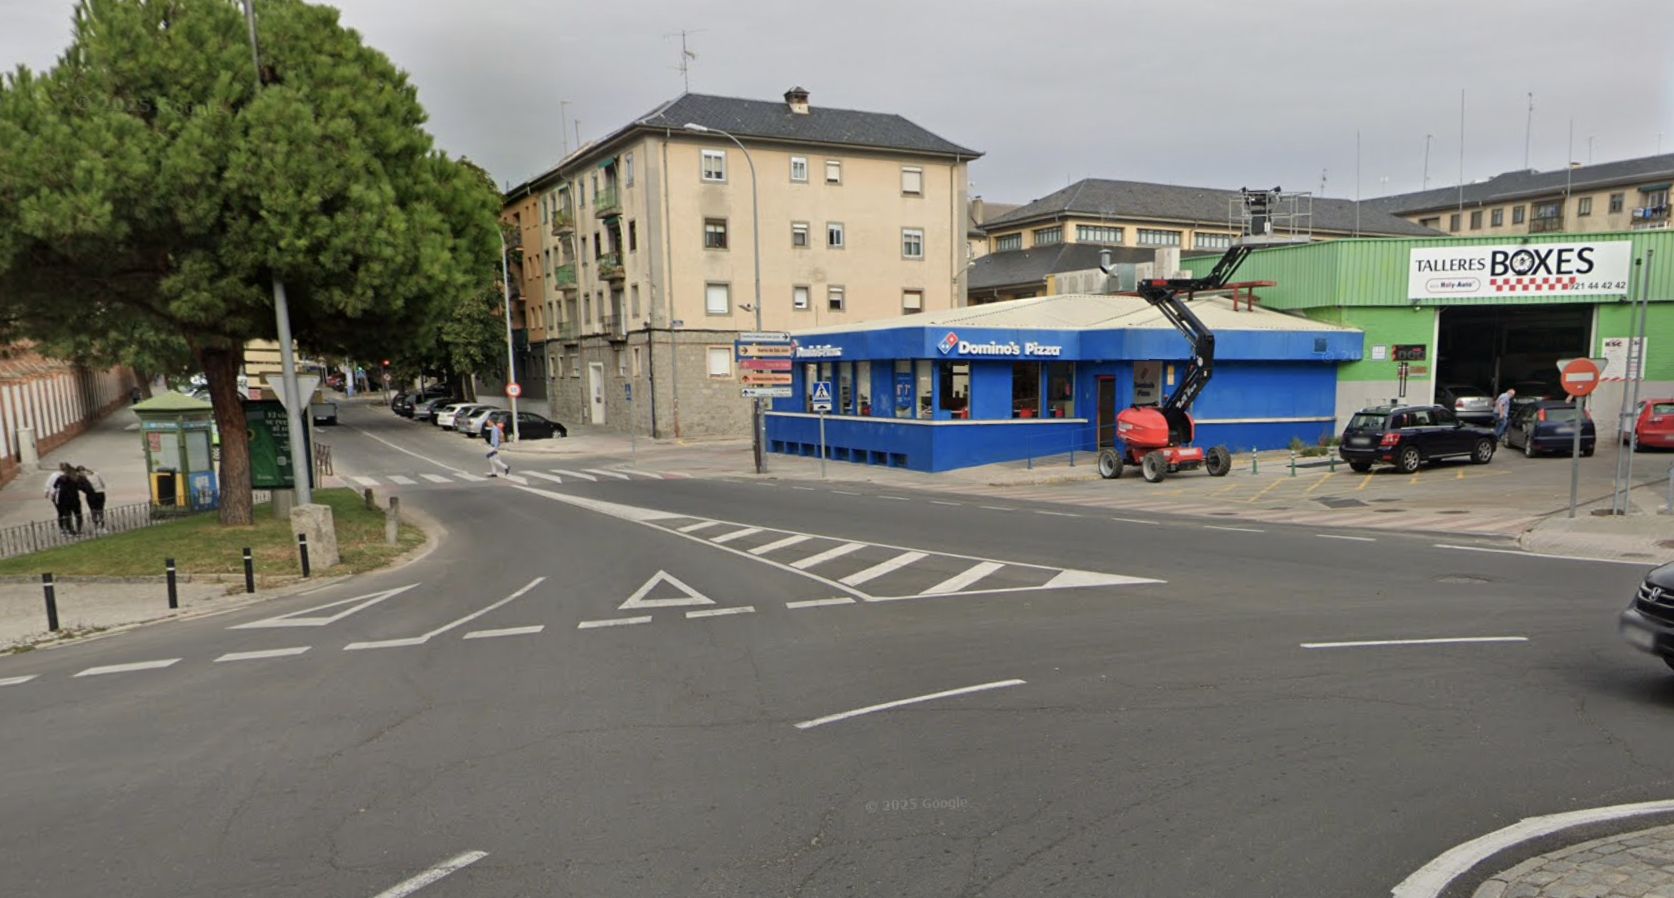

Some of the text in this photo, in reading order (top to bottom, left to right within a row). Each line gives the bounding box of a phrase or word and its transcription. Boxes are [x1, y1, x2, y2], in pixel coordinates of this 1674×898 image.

[1416, 247, 1595, 276] TALLERES BOXES
[1588, 282, 1599, 290] 44
[1601, 281, 1613, 289] 42
[1615, 281, 1626, 289] 42
[958, 340, 1061, 356] Domino's Pizza
